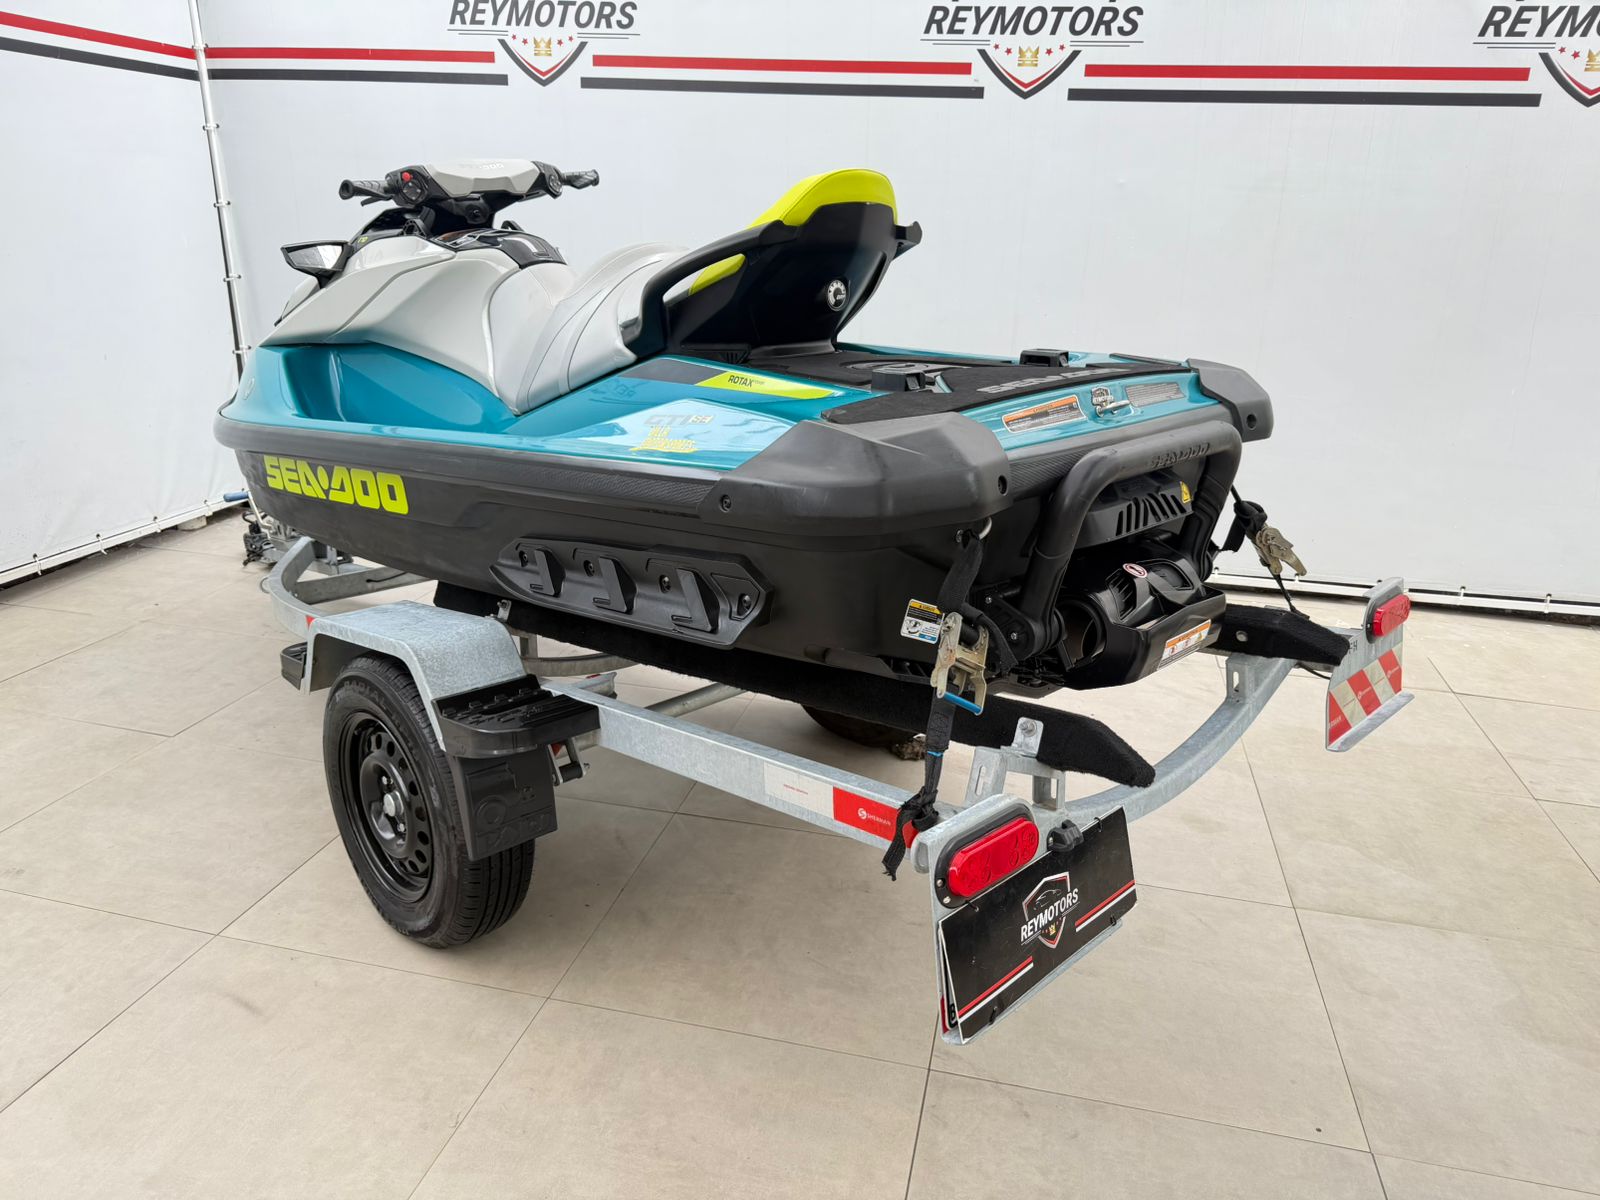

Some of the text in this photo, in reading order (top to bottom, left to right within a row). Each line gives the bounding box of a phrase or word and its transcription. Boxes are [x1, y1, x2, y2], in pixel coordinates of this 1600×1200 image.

[448, 0, 638, 30] REYMOTORS
[923, 5, 1144, 37] REYMOTORS
[1477, 5, 1600, 38] REYM
[727, 374, 753, 388] ROTAX
[1020, 887, 1079, 942] REYMOTORS
